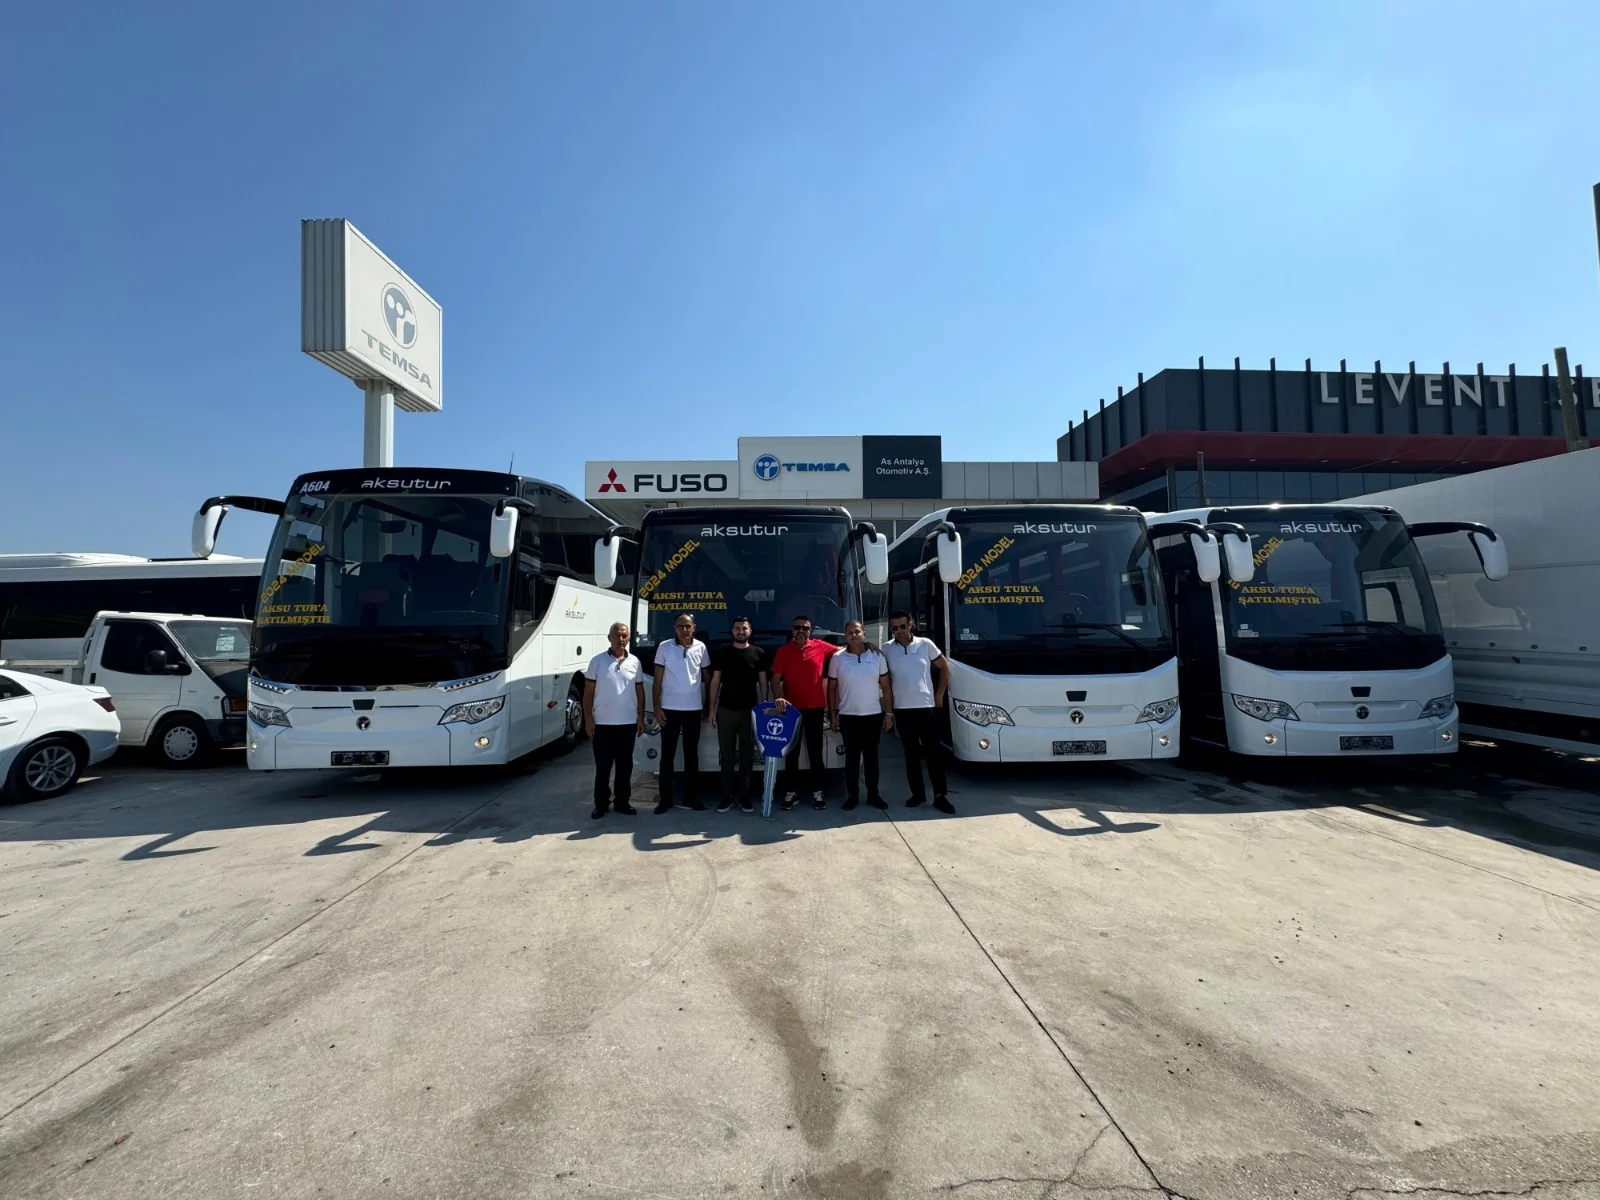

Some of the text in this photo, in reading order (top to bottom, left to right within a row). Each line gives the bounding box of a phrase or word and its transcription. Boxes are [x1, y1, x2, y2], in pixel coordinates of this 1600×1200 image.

[361, 328, 433, 389] TEMSA
[1320, 372, 1511, 407] LEVENT
[781, 462, 851, 472] TEMSA
[880, 457, 925, 467] As Antalya
[876, 467, 914, 475] Otomotiv
[299, 480, 331, 493] A604
[361, 477, 451, 489] aksutur
[634, 473, 728, 493] FUSO
[700, 524, 789, 537] aksutur
[1013, 521, 1097, 534] aksutur
[1280, 521, 1362, 534] aksutur
[1253, 536, 1284, 567] MODEL
[639, 539, 701, 598] 2024 MODEL
[956, 535, 1015, 590] 2024 MODEL
[260, 543, 326, 603] 2024 MODEL
[652, 591, 724, 600] AKSU TUR'A
[968, 585, 1040, 594] AKSU TUR'A
[1241, 586, 1316, 594] AKSU TUR'A
[964, 595, 1045, 605] SATILMIŞTIR
[261, 604, 329, 613] AKSU TUR'A
[648, 602, 728, 611] SATILMIŞTIR
[760, 734, 788, 742] TEMSA
